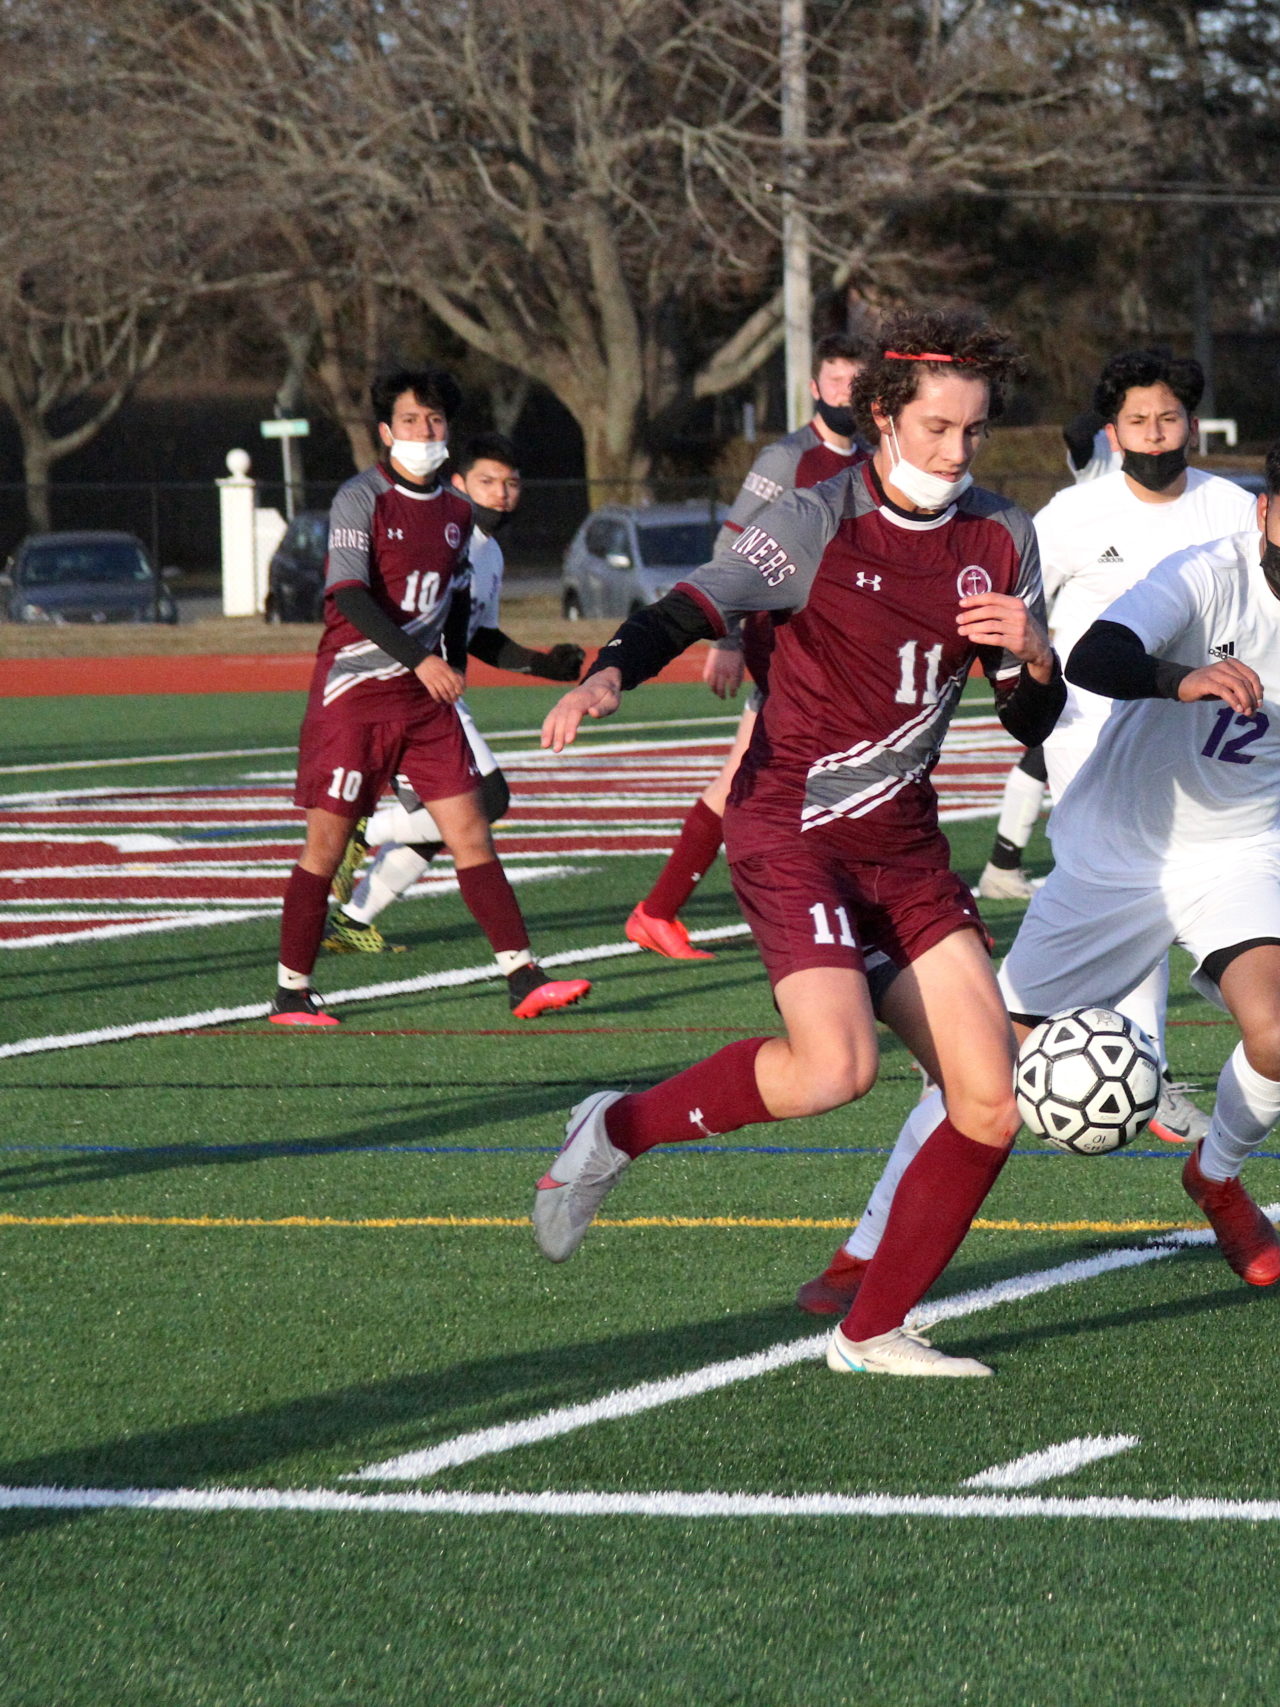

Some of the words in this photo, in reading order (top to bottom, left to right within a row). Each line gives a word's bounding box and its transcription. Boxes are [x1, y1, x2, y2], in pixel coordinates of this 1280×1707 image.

[400, 570, 440, 613] 10
[895, 640, 944, 704] 11
[1201, 707, 1270, 764] 12
[327, 766, 363, 802] 10
[808, 902, 856, 948] 11
